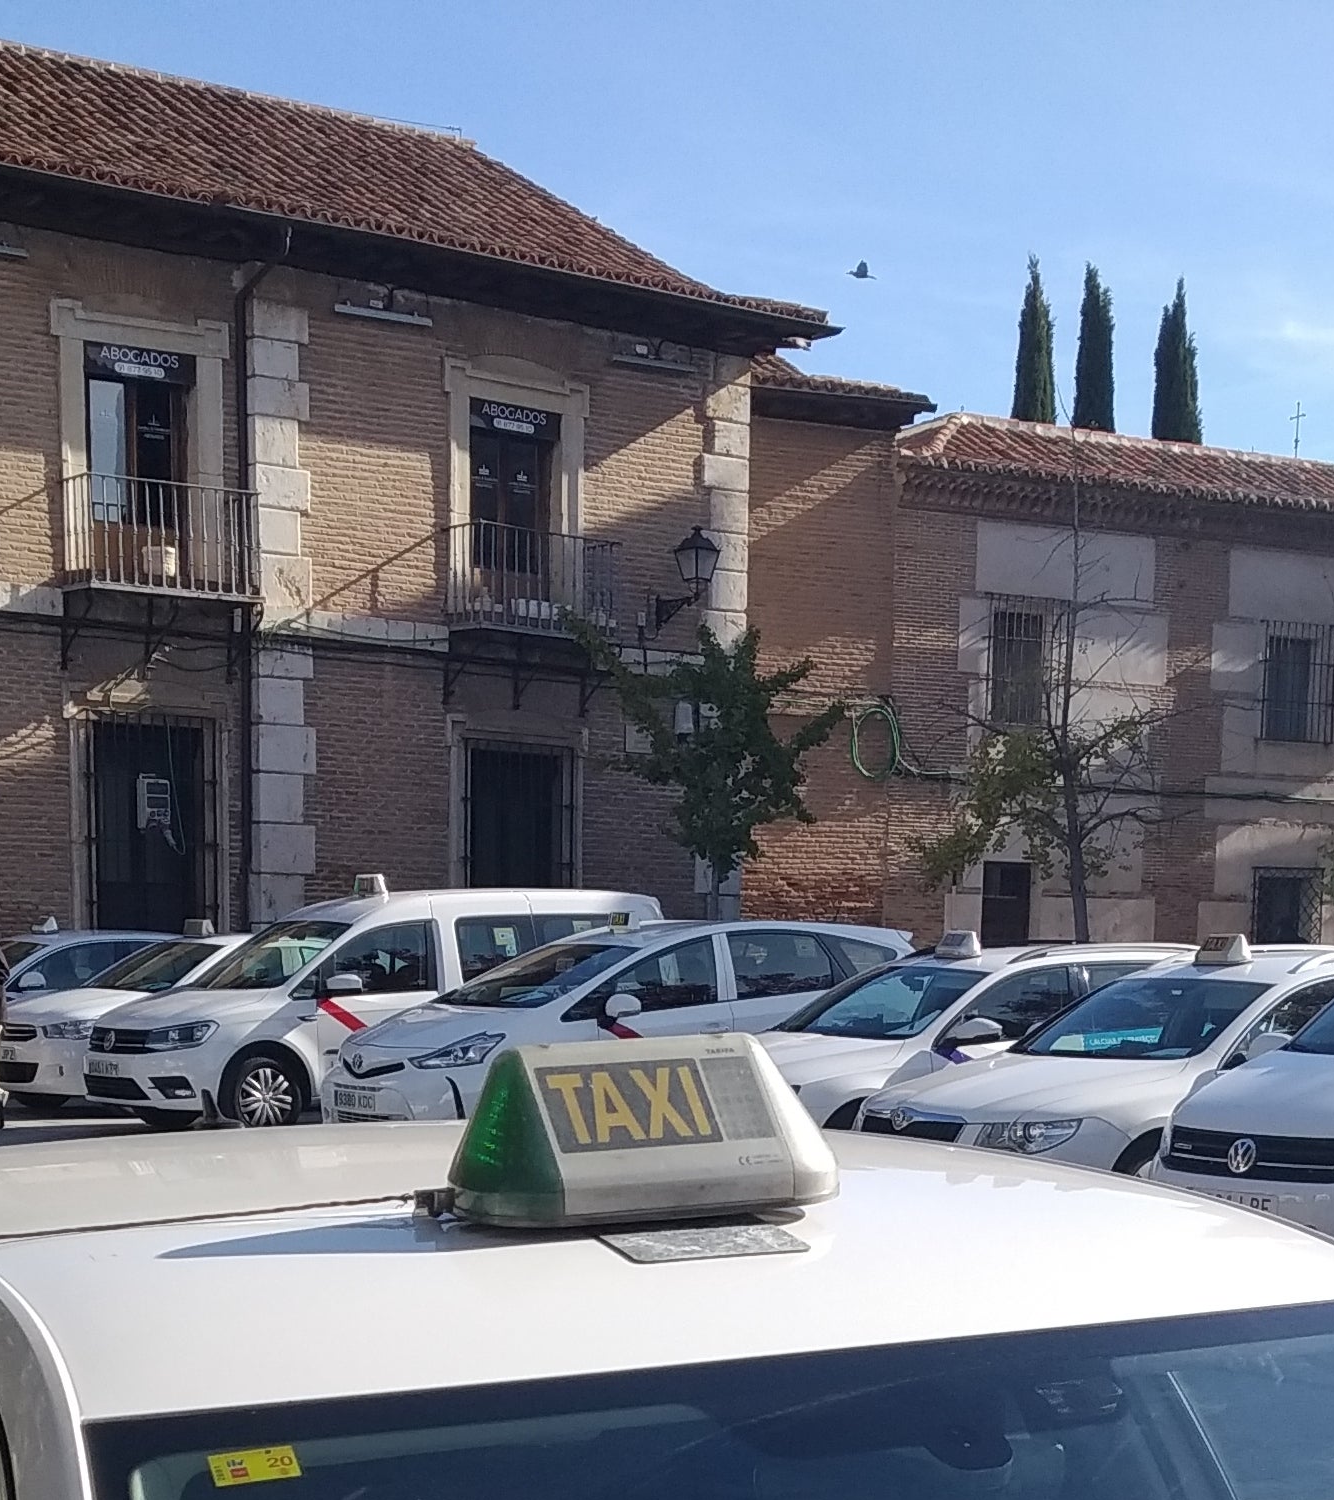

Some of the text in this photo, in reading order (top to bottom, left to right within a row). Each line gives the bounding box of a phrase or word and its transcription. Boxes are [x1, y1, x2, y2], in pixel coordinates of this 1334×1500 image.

[100, 346, 179, 368] ABOGADOS
[482, 402, 547, 425] ABOGADOS
[546, 1065, 712, 1145] TAXI
[267, 1455, 293, 1468] 20
